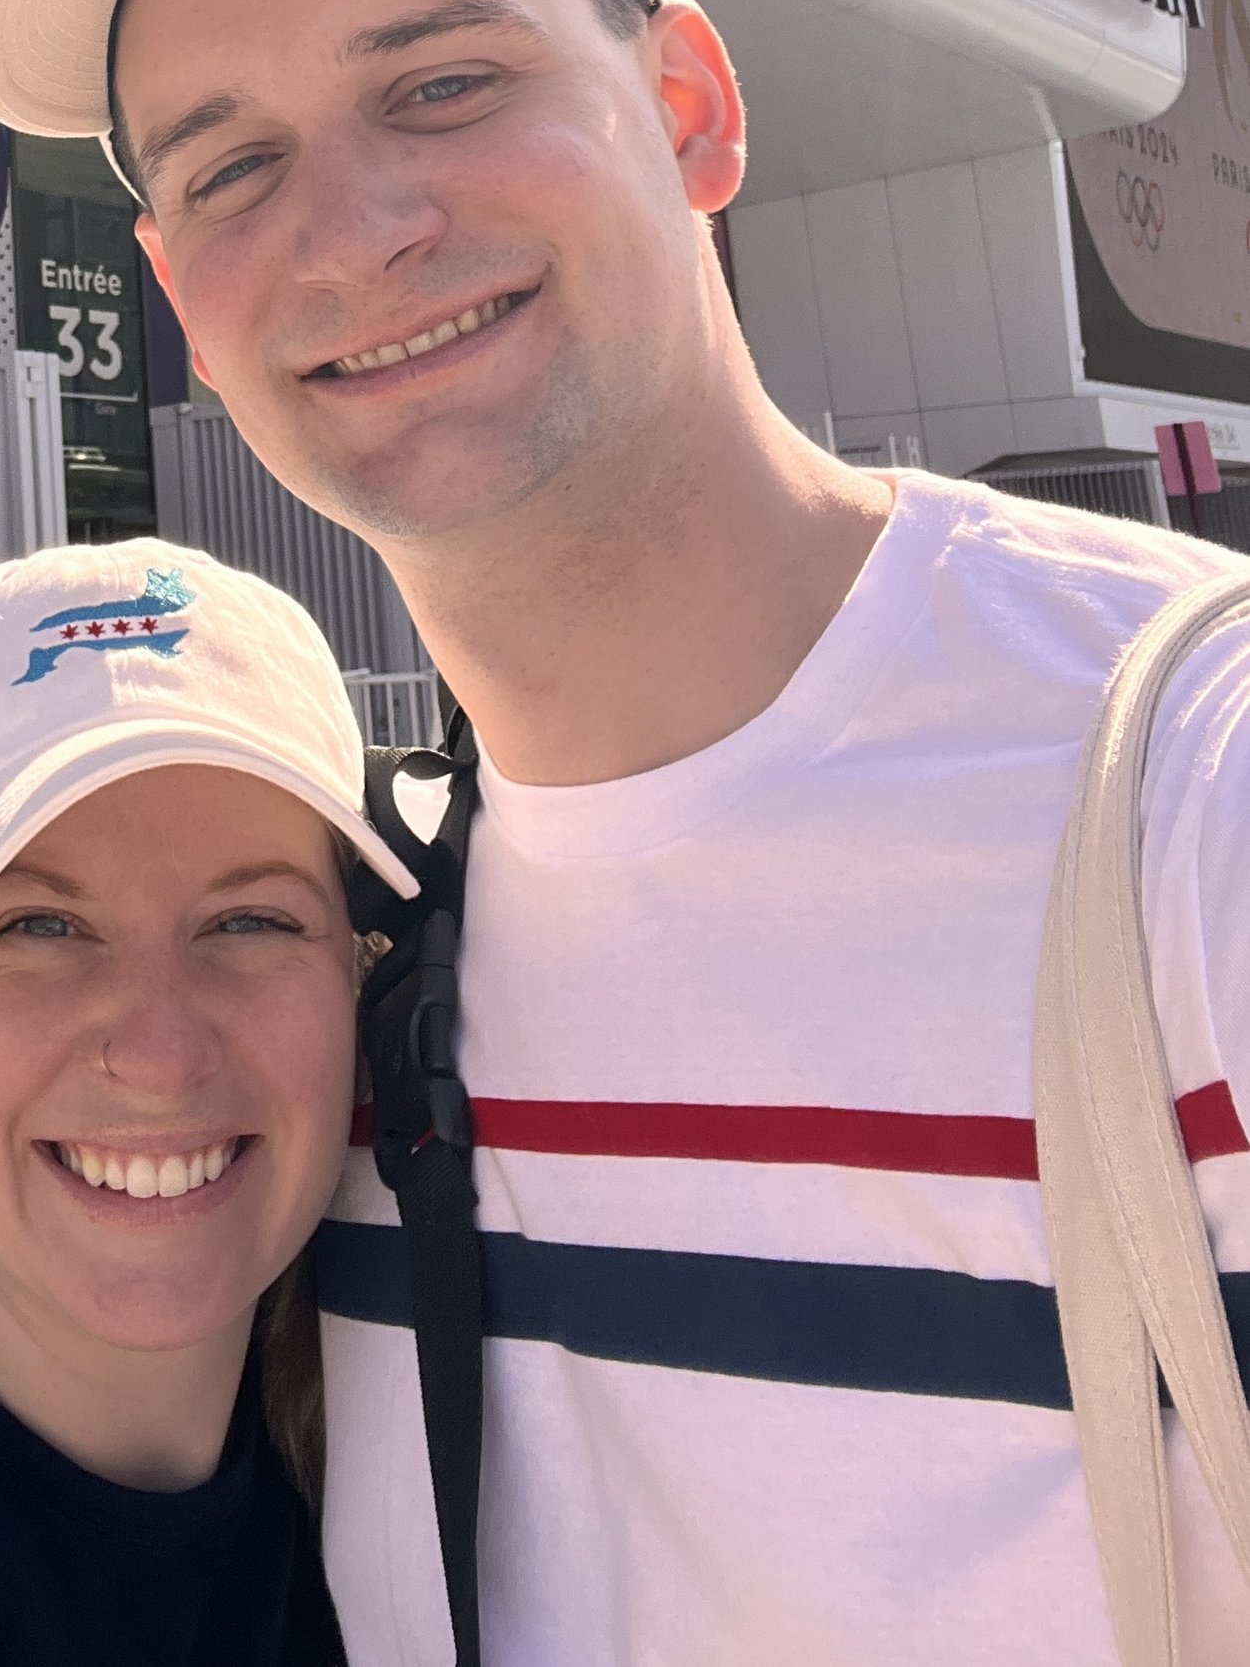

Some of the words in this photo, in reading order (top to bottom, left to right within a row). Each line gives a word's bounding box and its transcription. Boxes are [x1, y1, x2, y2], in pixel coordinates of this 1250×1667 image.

[1137, 123, 1180, 167] 2024
[41, 259, 123, 297] Entrée
[49, 305, 123, 381] 33
